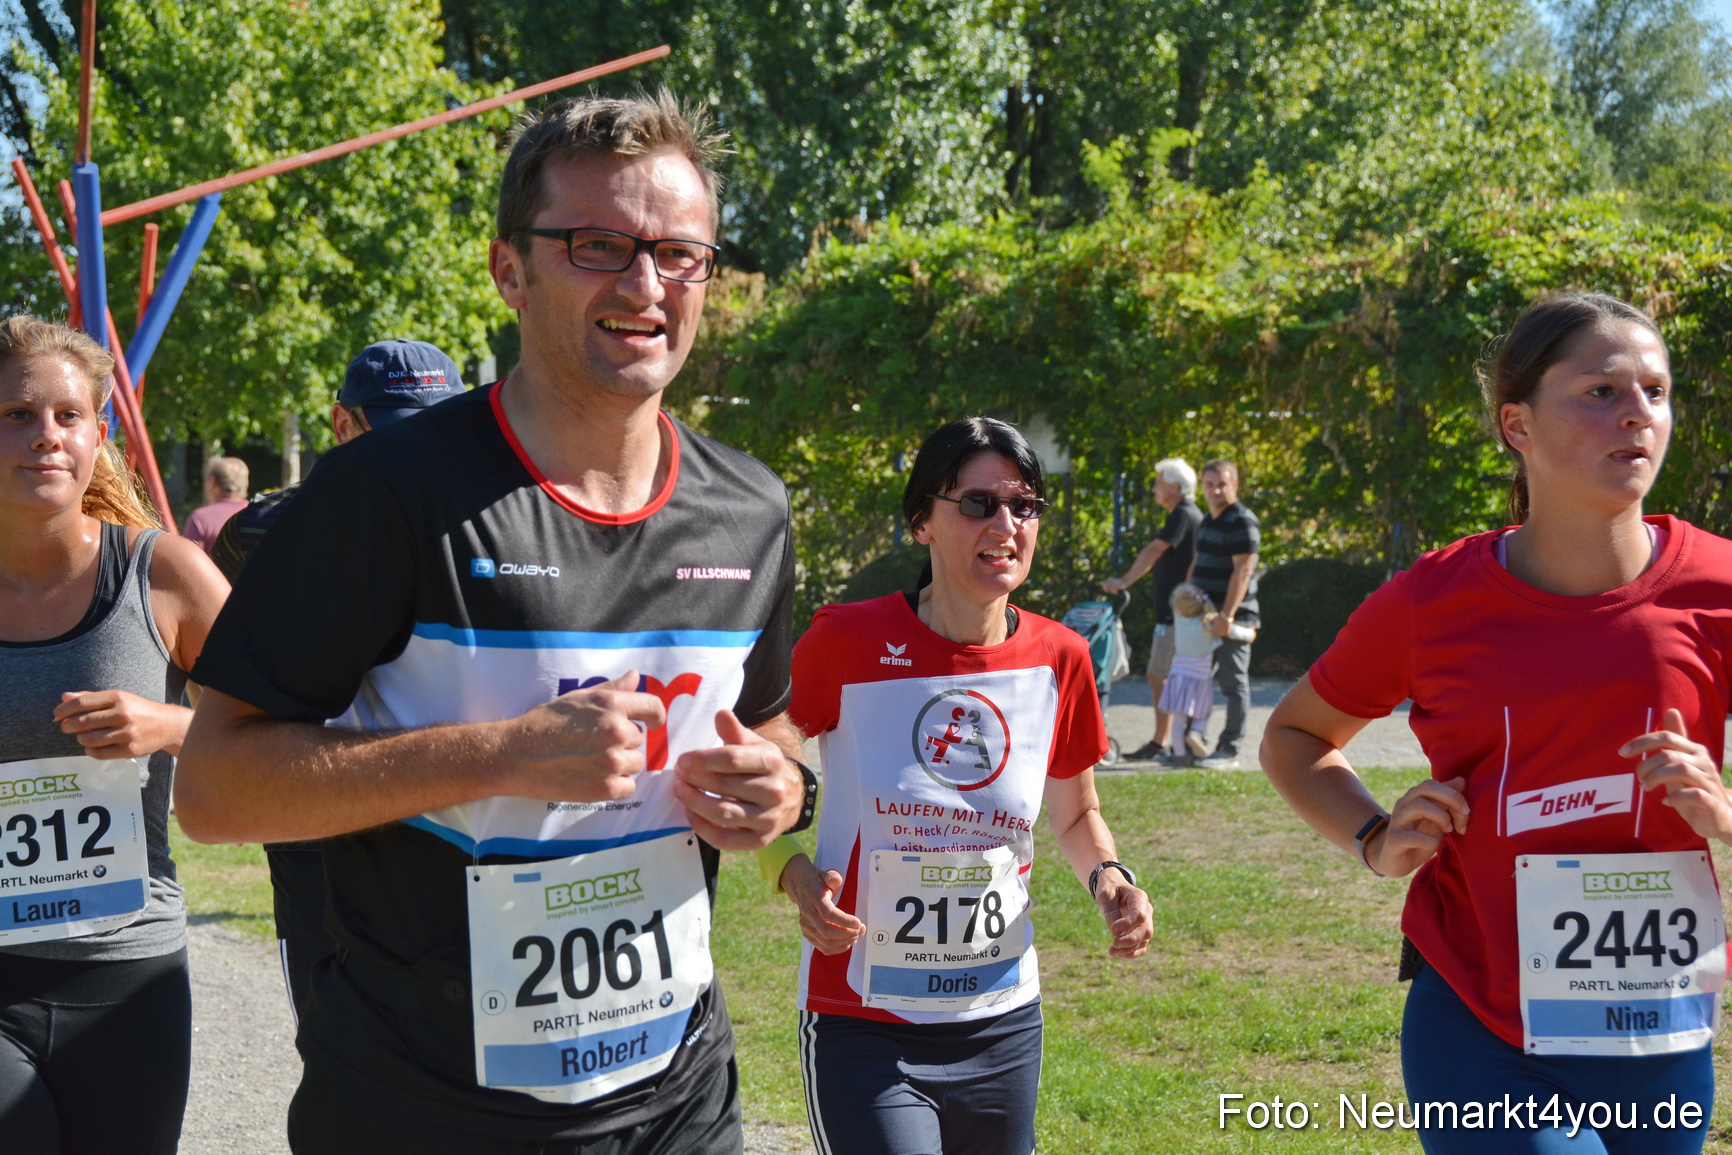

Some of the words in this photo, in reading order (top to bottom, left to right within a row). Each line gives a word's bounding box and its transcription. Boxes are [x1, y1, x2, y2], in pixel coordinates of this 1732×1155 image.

[676, 567, 692, 580] SV
[692, 567, 752, 581] ILLSCHWANG
[880, 655, 912, 667] erima
[0, 773, 81, 800] BOCK
[31, 795, 51, 804] smart
[52, 792, 83, 802] concepts
[1540, 789, 1598, 817] DEHN
[0, 805, 115, 870] 312
[893, 825, 911, 835] Dr.
[914, 825, 942, 837] Heck
[952, 825, 968, 835] Dr.
[0, 877, 27, 889] RTL
[29, 869, 89, 886] Neumarkt
[921, 866, 994, 883] BOCK
[1582, 870, 1673, 893] BOCK
[544, 868, 643, 912] BOCK
[1583, 893, 1613, 902] inspired
[1623, 892, 1644, 900] smart
[12, 898, 82, 925] Laura
[545, 907, 577, 921] inspired
[590, 901, 614, 911] smart
[894, 890, 1006, 946] 2178
[877, 934, 885, 942] D
[1552, 907, 1699, 970] 2443
[512, 909, 673, 1008] 2061
[904, 952, 941, 963] PARTL
[943, 950, 988, 963] Neumarkt
[1533, 958, 1541, 969] B
[927, 973, 979, 994] Doris
[1569, 980, 1615, 992] PARTL
[1617, 979, 1676, 992] Neumarkt
[488, 996, 498, 1010] D
[533, 1013, 584, 1034] PARTL
[587, 999, 655, 1023] Neumarkt
[1605, 1006, 1660, 1031] Nina
[560, 1030, 649, 1079] Robert
